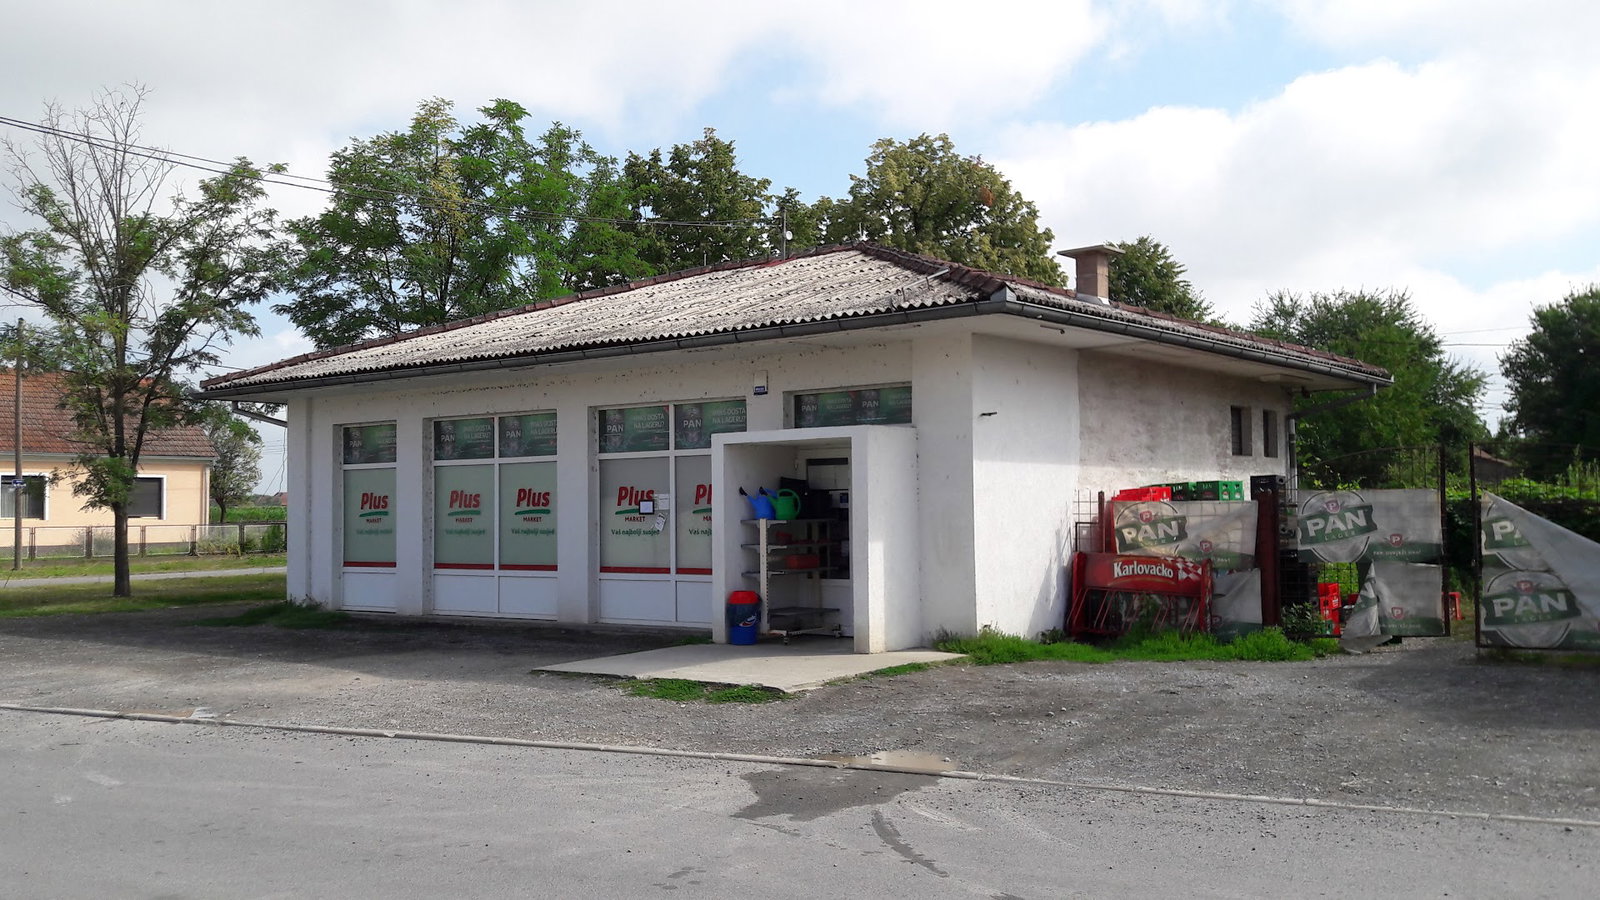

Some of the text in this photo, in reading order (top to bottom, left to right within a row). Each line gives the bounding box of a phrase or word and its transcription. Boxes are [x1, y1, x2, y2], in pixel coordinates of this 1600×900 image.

[801, 404, 818, 412] PAN
[862, 400, 879, 408] PAN
[606, 423, 624, 432] PAN
[683, 419, 702, 428] PAN
[505, 430, 522, 438] PAN
[349, 440, 362, 448] PAN
[360, 492, 388, 510] Plus
[449, 490, 481, 509] Plus
[516, 488, 550, 508] Plus
[616, 486, 655, 507] Plus
[1306, 509, 1367, 537] PAN
[1121, 520, 1179, 545] PAN
[1492, 592, 1568, 618] PAN
